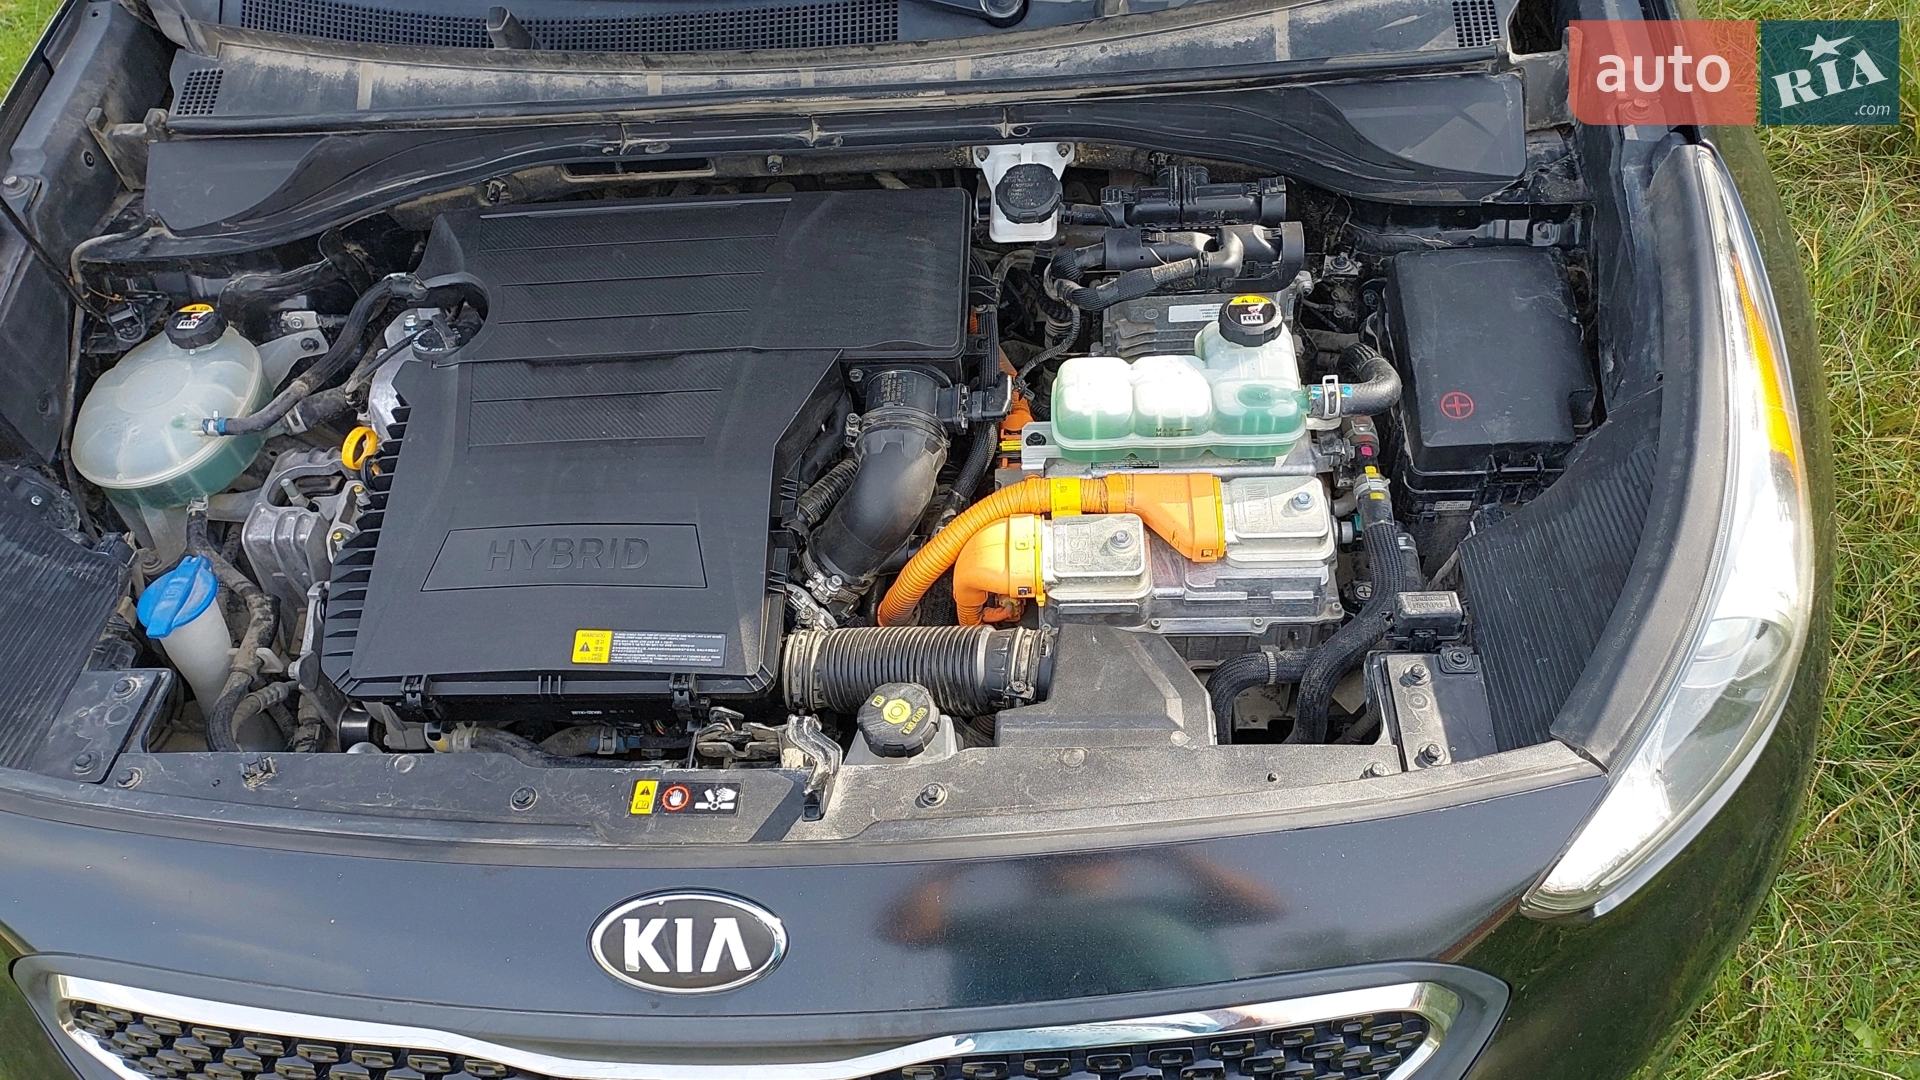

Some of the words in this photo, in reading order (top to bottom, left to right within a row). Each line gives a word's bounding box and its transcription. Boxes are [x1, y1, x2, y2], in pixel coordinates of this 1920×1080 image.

[485, 537, 650, 571] HYBRID
[1069, 525, 1089, 564] HSG
[623, 917, 752, 973] KIA
